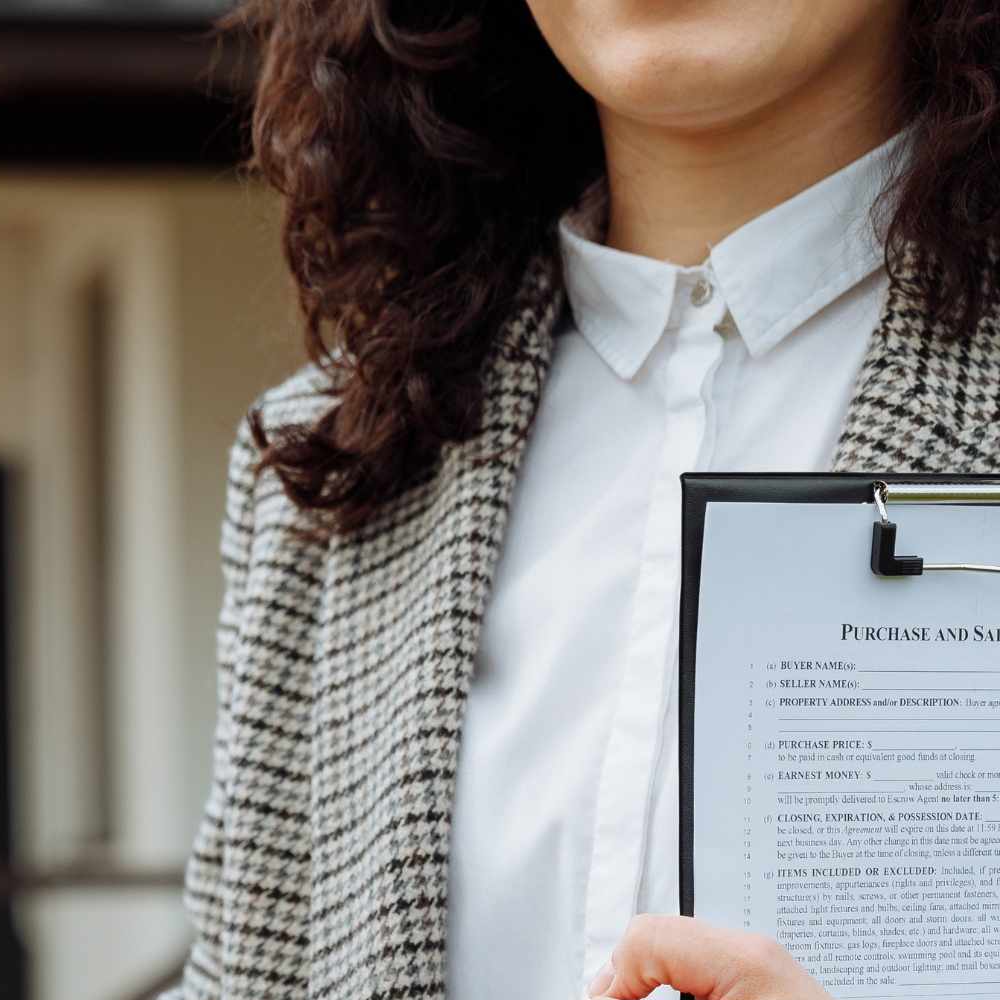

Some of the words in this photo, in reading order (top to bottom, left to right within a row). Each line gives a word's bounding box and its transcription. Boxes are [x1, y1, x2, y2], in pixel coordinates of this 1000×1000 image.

[841, 623, 931, 642] PURCHASE
[935, 627, 969, 642] AND
[780, 661, 813, 670] BUYER
[779, 679, 817, 688] SELLER
[779, 697, 828, 706] PROPERTY
[830, 698, 871, 707] ADDRESS
[873, 697, 898, 707] and/or
[778, 740, 830, 749] PURCHASE
[855, 752, 895, 763] equivalent
[897, 752, 916, 763] good
[778, 770, 822, 780] EARNEST
[953, 794, 971, 803] later
[973, 793, 991, 803] than
[888, 813, 896, 822] &
[898, 812, 953, 822] POSSESSION
[777, 868, 808, 878] ITEMS
[811, 867, 862, 877] INCLUDED
[865, 867, 880, 876] OR
